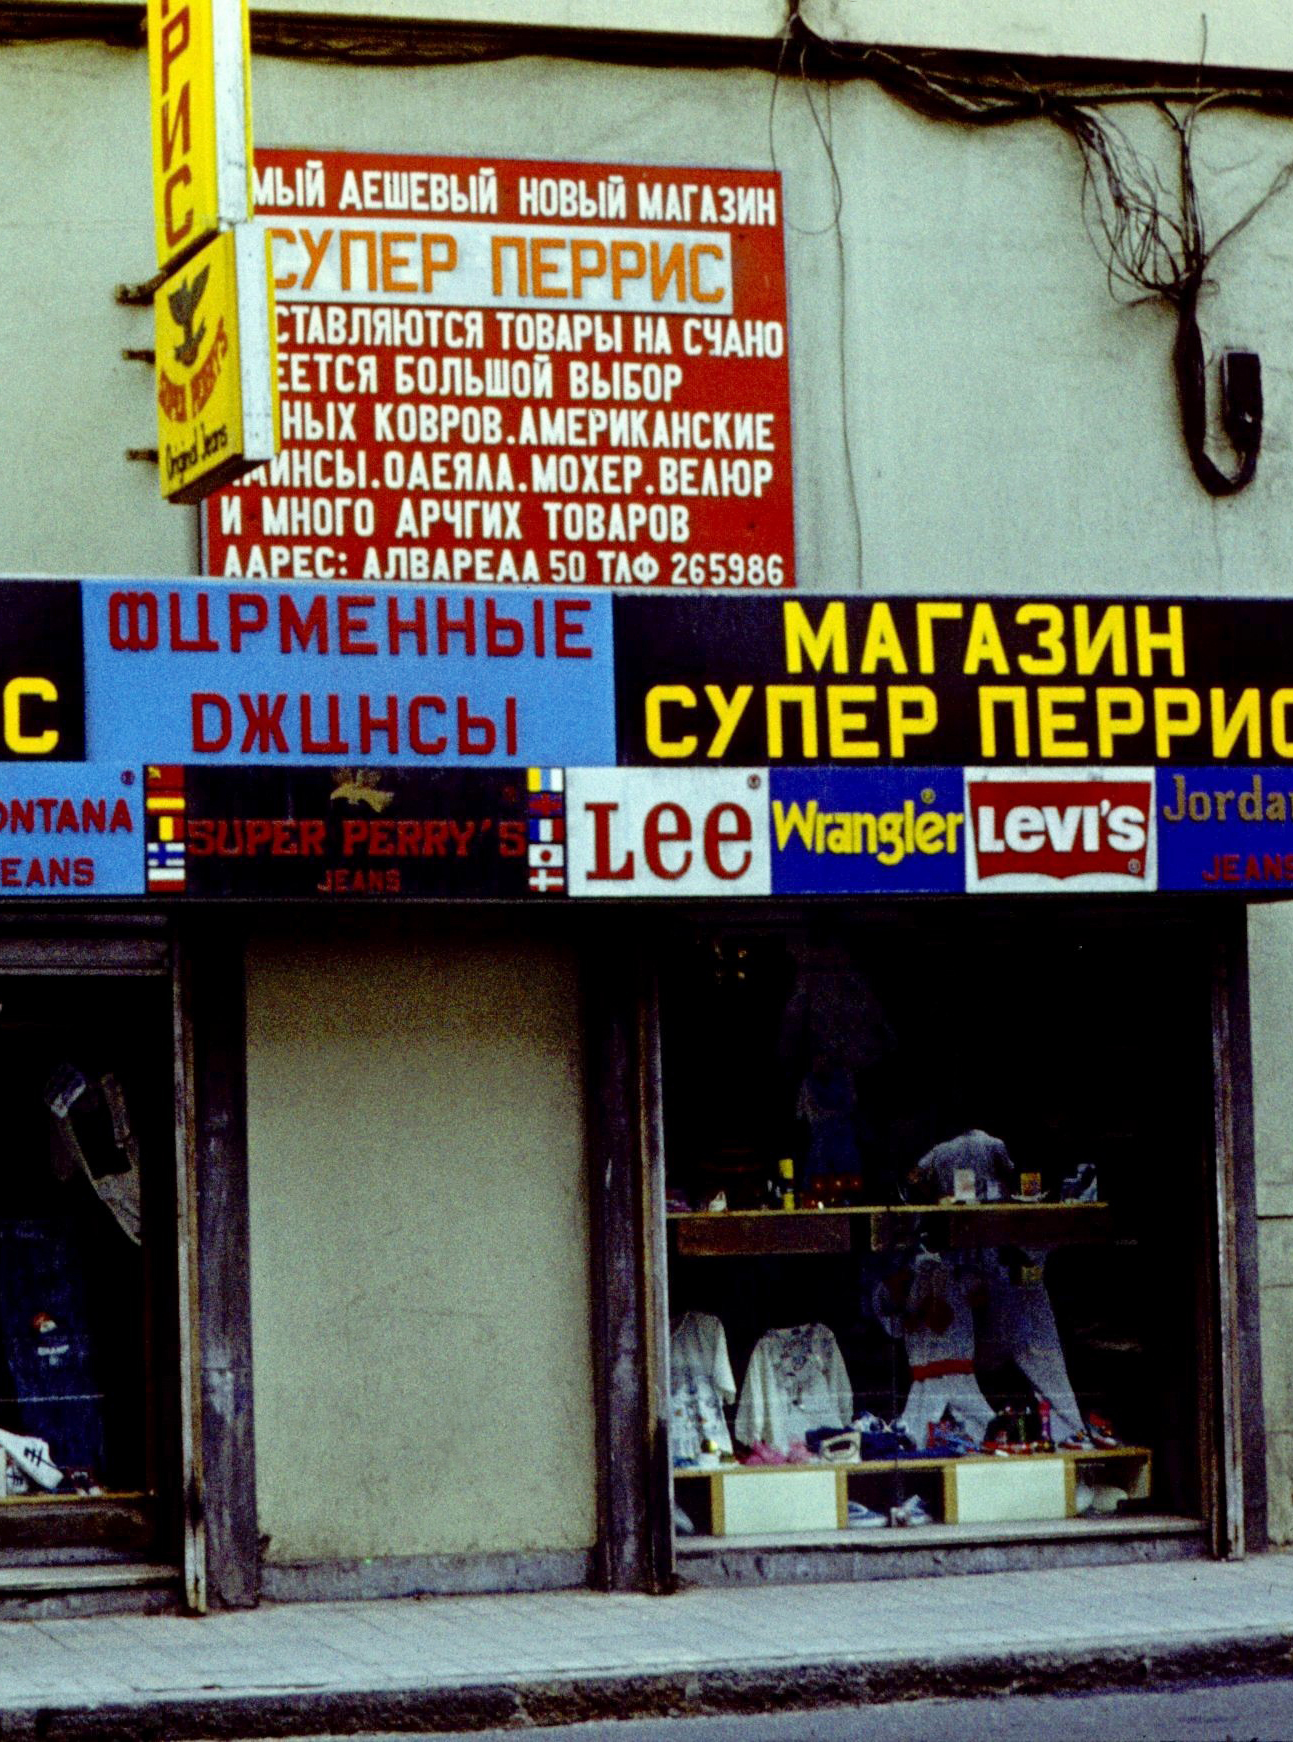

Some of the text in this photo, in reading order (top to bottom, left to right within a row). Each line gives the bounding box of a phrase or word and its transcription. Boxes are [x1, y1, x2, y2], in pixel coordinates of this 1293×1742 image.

[519, 176, 626, 220] НОВЫЙ
[638, 183, 776, 226] МАГАЗИН
[270, 228, 725, 304] СУПЕР ПЕРРИС
[496, 312, 622, 353] ТОВАРЫ
[633, 316, 672, 355] НА
[395, 354, 553, 399] БОЛЬШОЙ
[569, 360, 682, 402] ВЫБОР
[220, 495, 242, 536] И
[261, 496, 374, 537] МНОГО
[543, 501, 690, 543] ТОВАРОВ
[548, 550, 586, 583] 50
[671, 553, 783, 586] 265986
[783, 602, 1186, 677] МАГАЗИН
[644, 684, 938, 760] СУПЕР
[1163, 774, 1293, 822] Jorda
[187, 818, 527, 858] SUPER PERRY'S
[584, 802, 753, 881] Lee
[772, 800, 964, 866] Wrangler
[317, 868, 402, 893] JEANS
